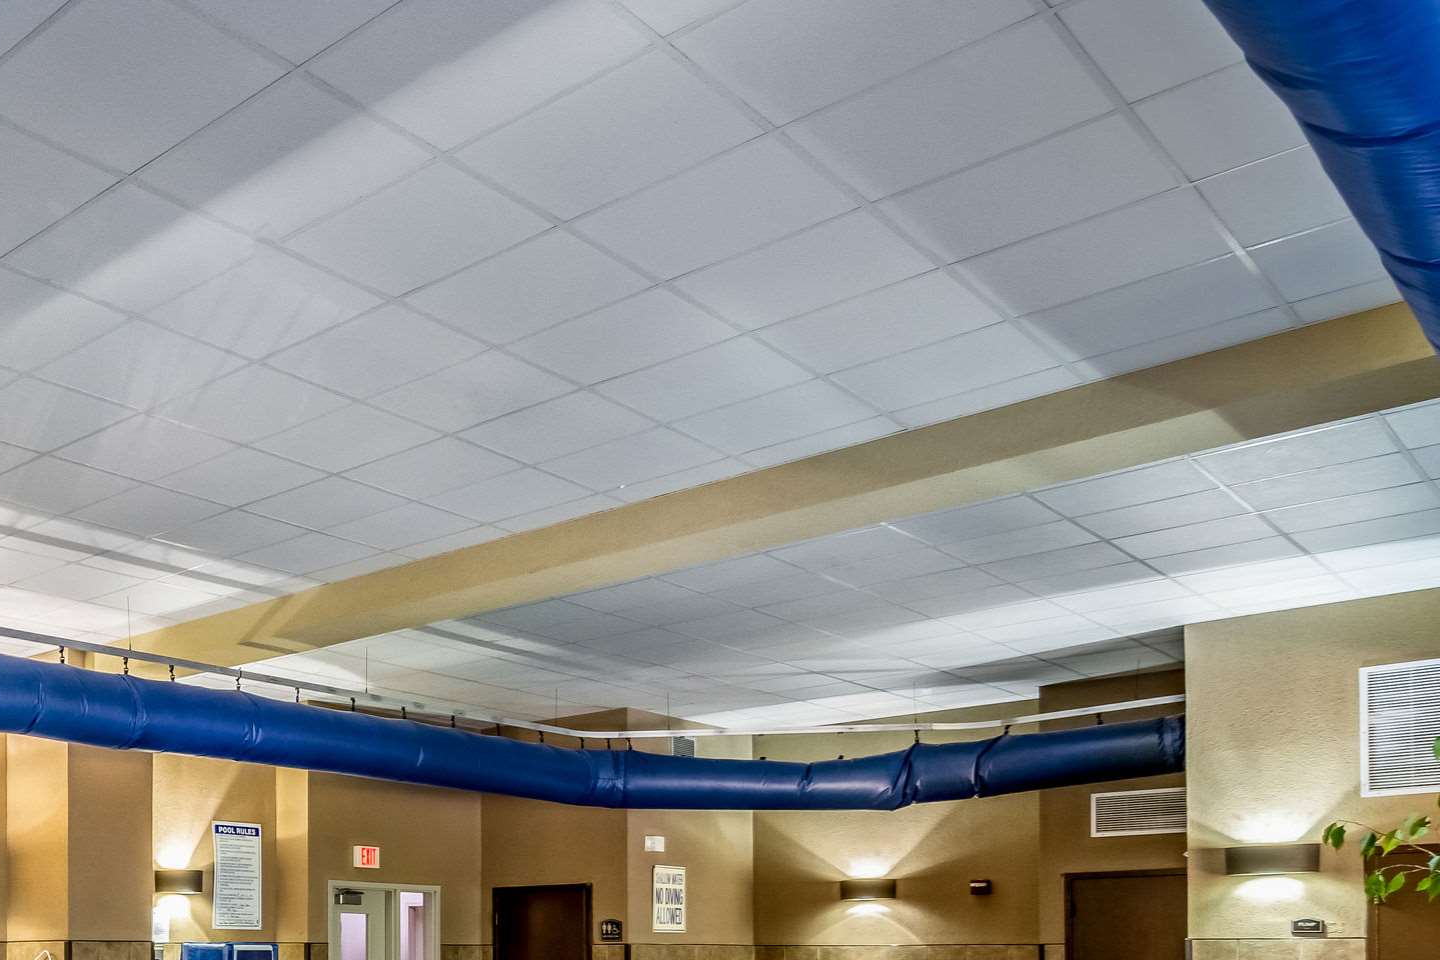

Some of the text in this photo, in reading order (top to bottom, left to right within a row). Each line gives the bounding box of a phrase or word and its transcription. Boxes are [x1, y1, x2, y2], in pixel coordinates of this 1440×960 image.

[218, 826, 256, 836] POOL RULES
[361, 847, 376, 865] EXIT
[656, 888, 683, 906] NO DIVING
[656, 907, 683, 925] ALLOWED
